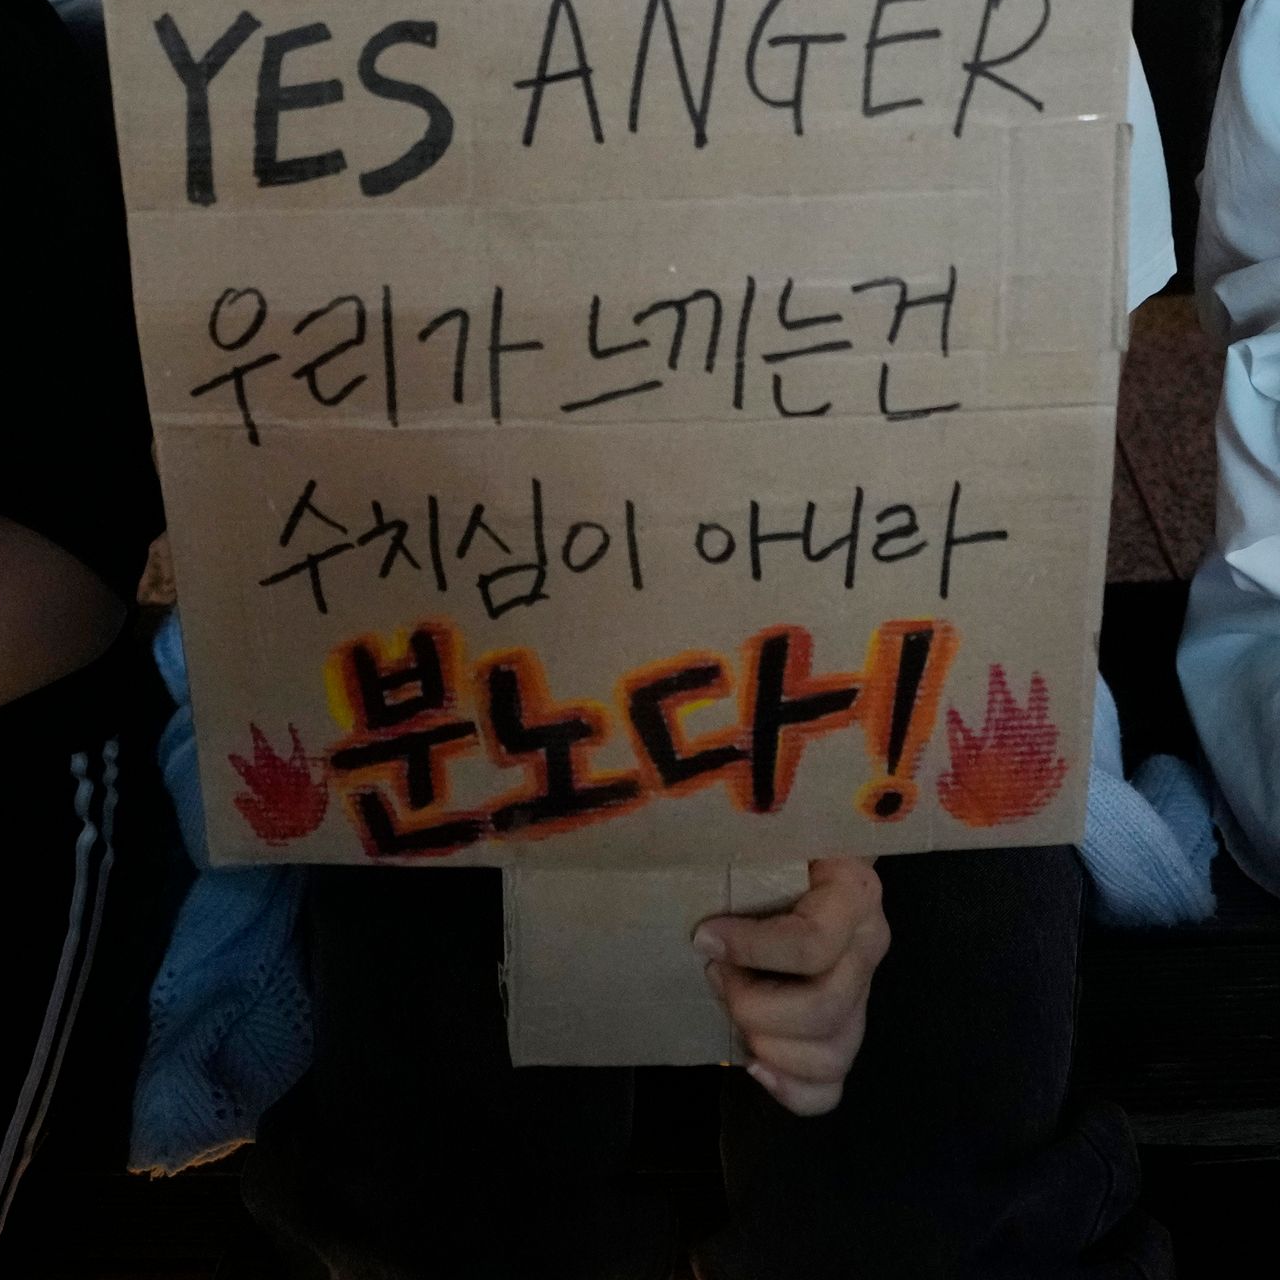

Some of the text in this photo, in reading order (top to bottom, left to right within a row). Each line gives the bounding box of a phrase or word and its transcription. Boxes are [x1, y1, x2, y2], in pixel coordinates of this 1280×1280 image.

[154, 9, 454, 205] YES
[192, 267, 959, 445] 우리가 느끼는건
[259, 480, 1008, 618] 수치심이 아니라
[330, 624, 945, 856] 분노다!
